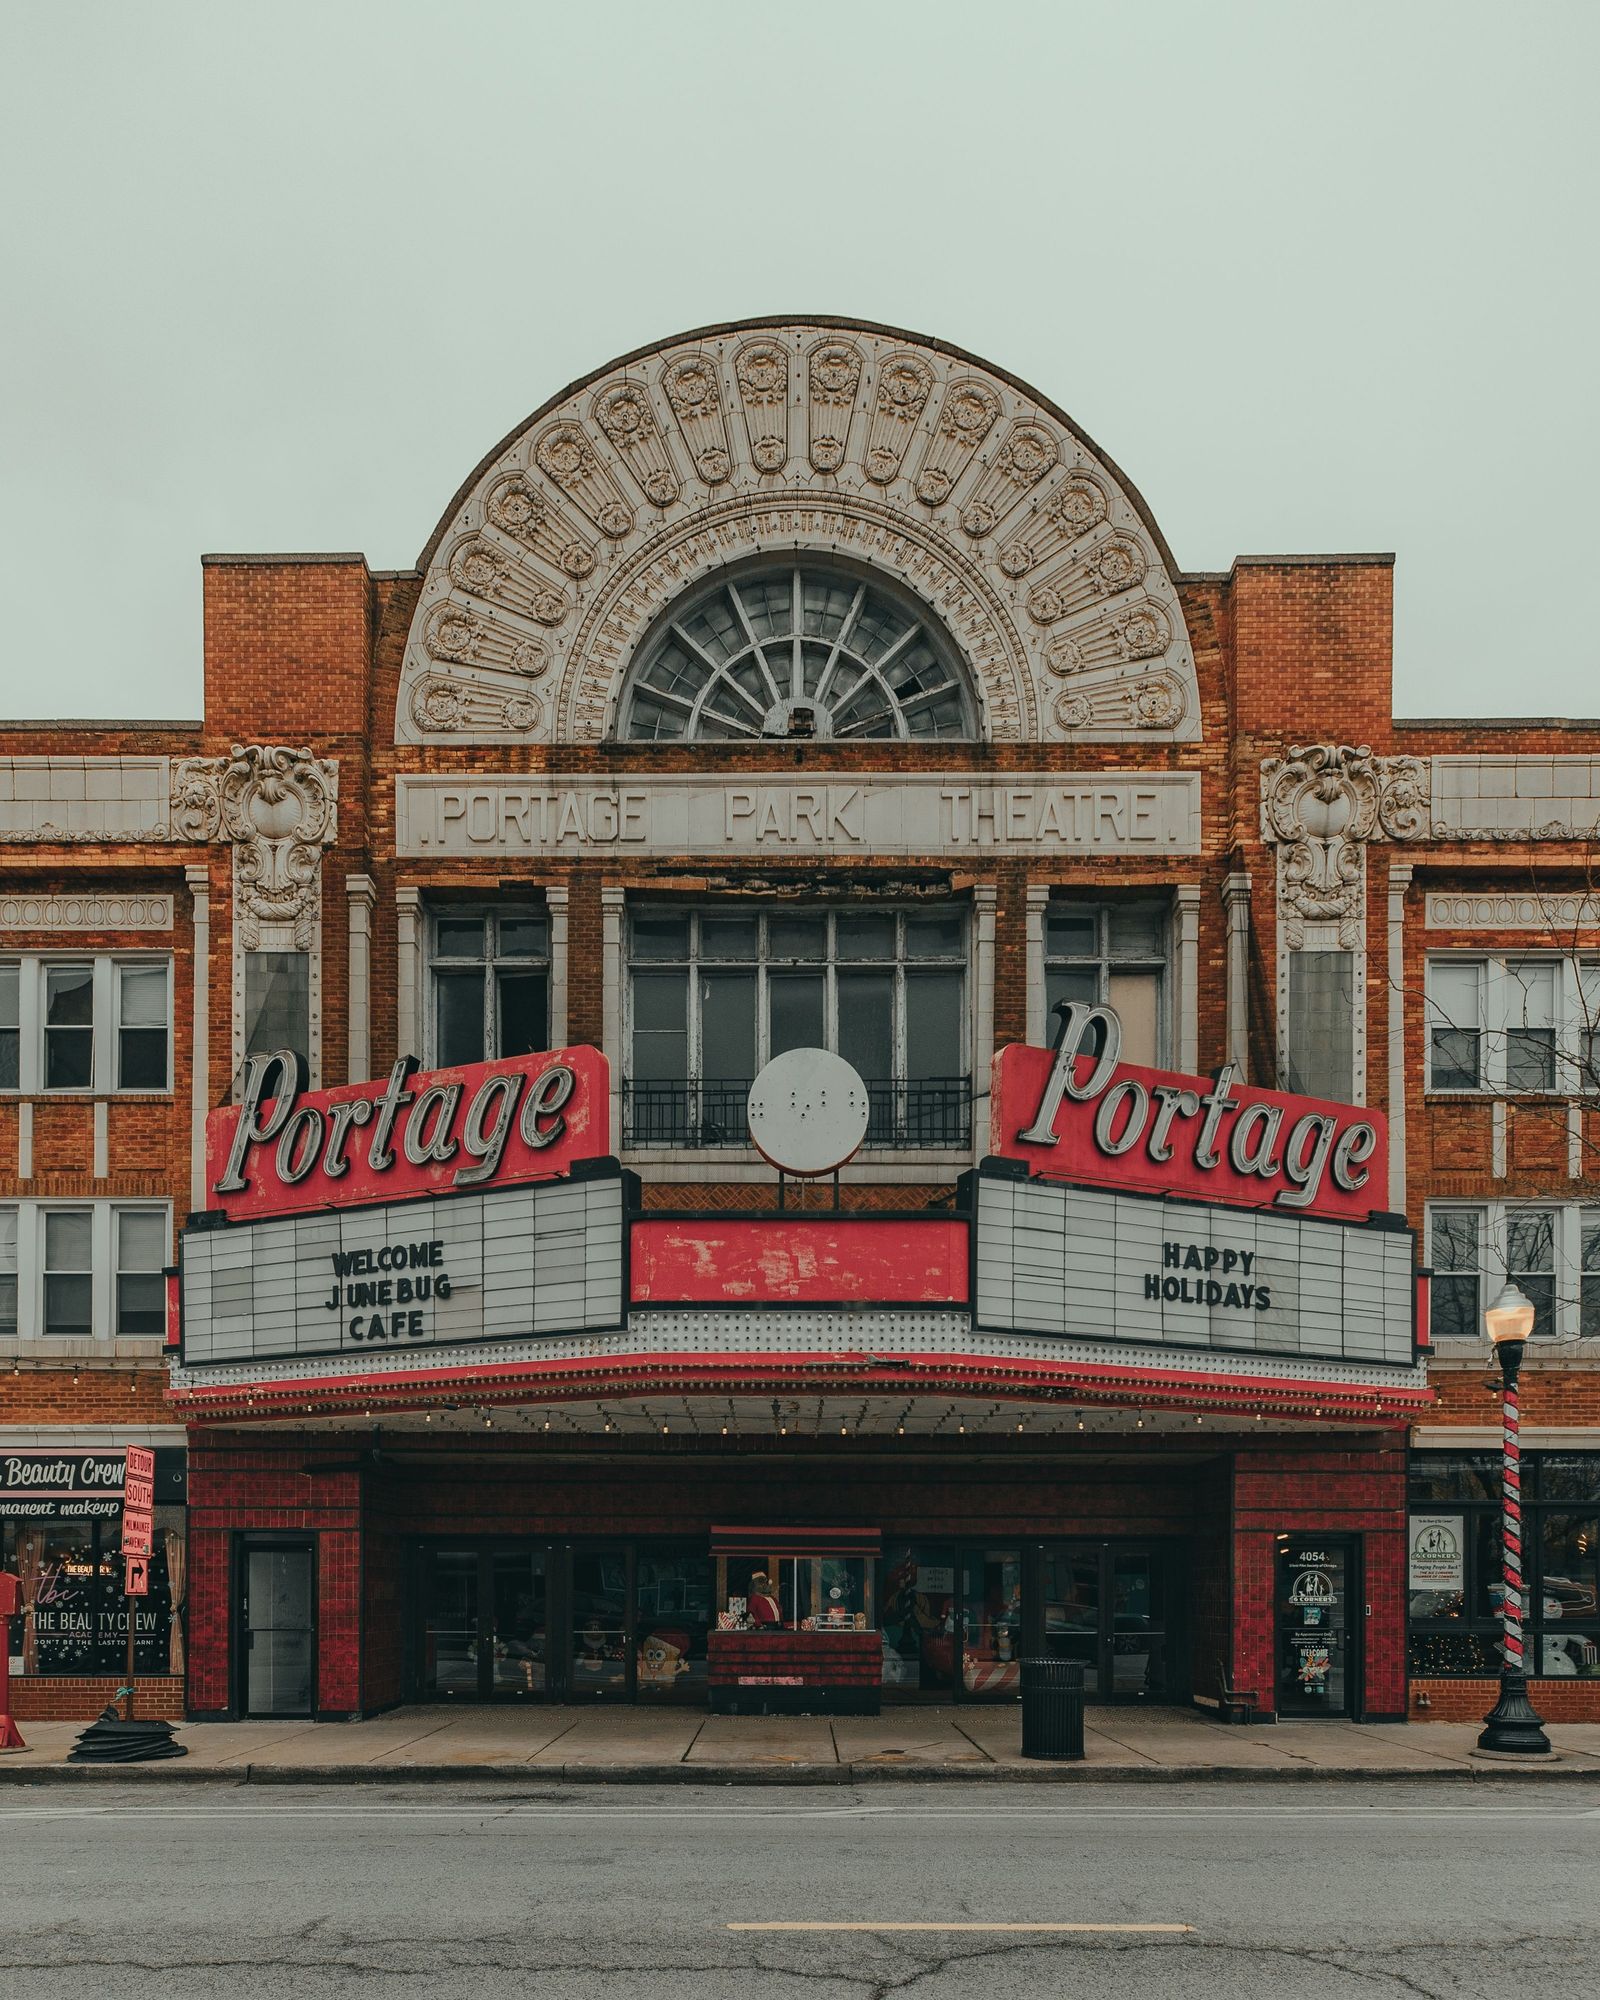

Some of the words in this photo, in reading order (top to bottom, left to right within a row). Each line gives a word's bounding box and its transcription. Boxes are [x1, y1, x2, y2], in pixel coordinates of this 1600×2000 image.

[725, 791, 860, 842] PARK
[1018, 1000, 1377, 1207] Portage
[212, 1048, 575, 1194] Portage
[331, 1240, 444, 1278] WELCOME
[1163, 1242, 1256, 1276] HAPPY
[1144, 1274, 1272, 1310] HOLIDAYS
[349, 1309, 424, 1341] CAFE
[5, 1457, 76, 1490] Beauty
[80, 1457, 126, 1485] Crew
[129, 1451, 153, 1474] DETOUR
[60, 1500, 119, 1516] makeup
[127, 1484, 152, 1505] SOUTH
[126, 1520, 150, 1534] MILWAUKEE
[128, 1536, 146, 1549] AVENUE
[1300, 1552, 1325, 1561] 4054
[32, 1612, 55, 1630] THE
[60, 1612, 114, 1630] BEAUTY
[1300, 1648, 1329, 1657] WELCOME
